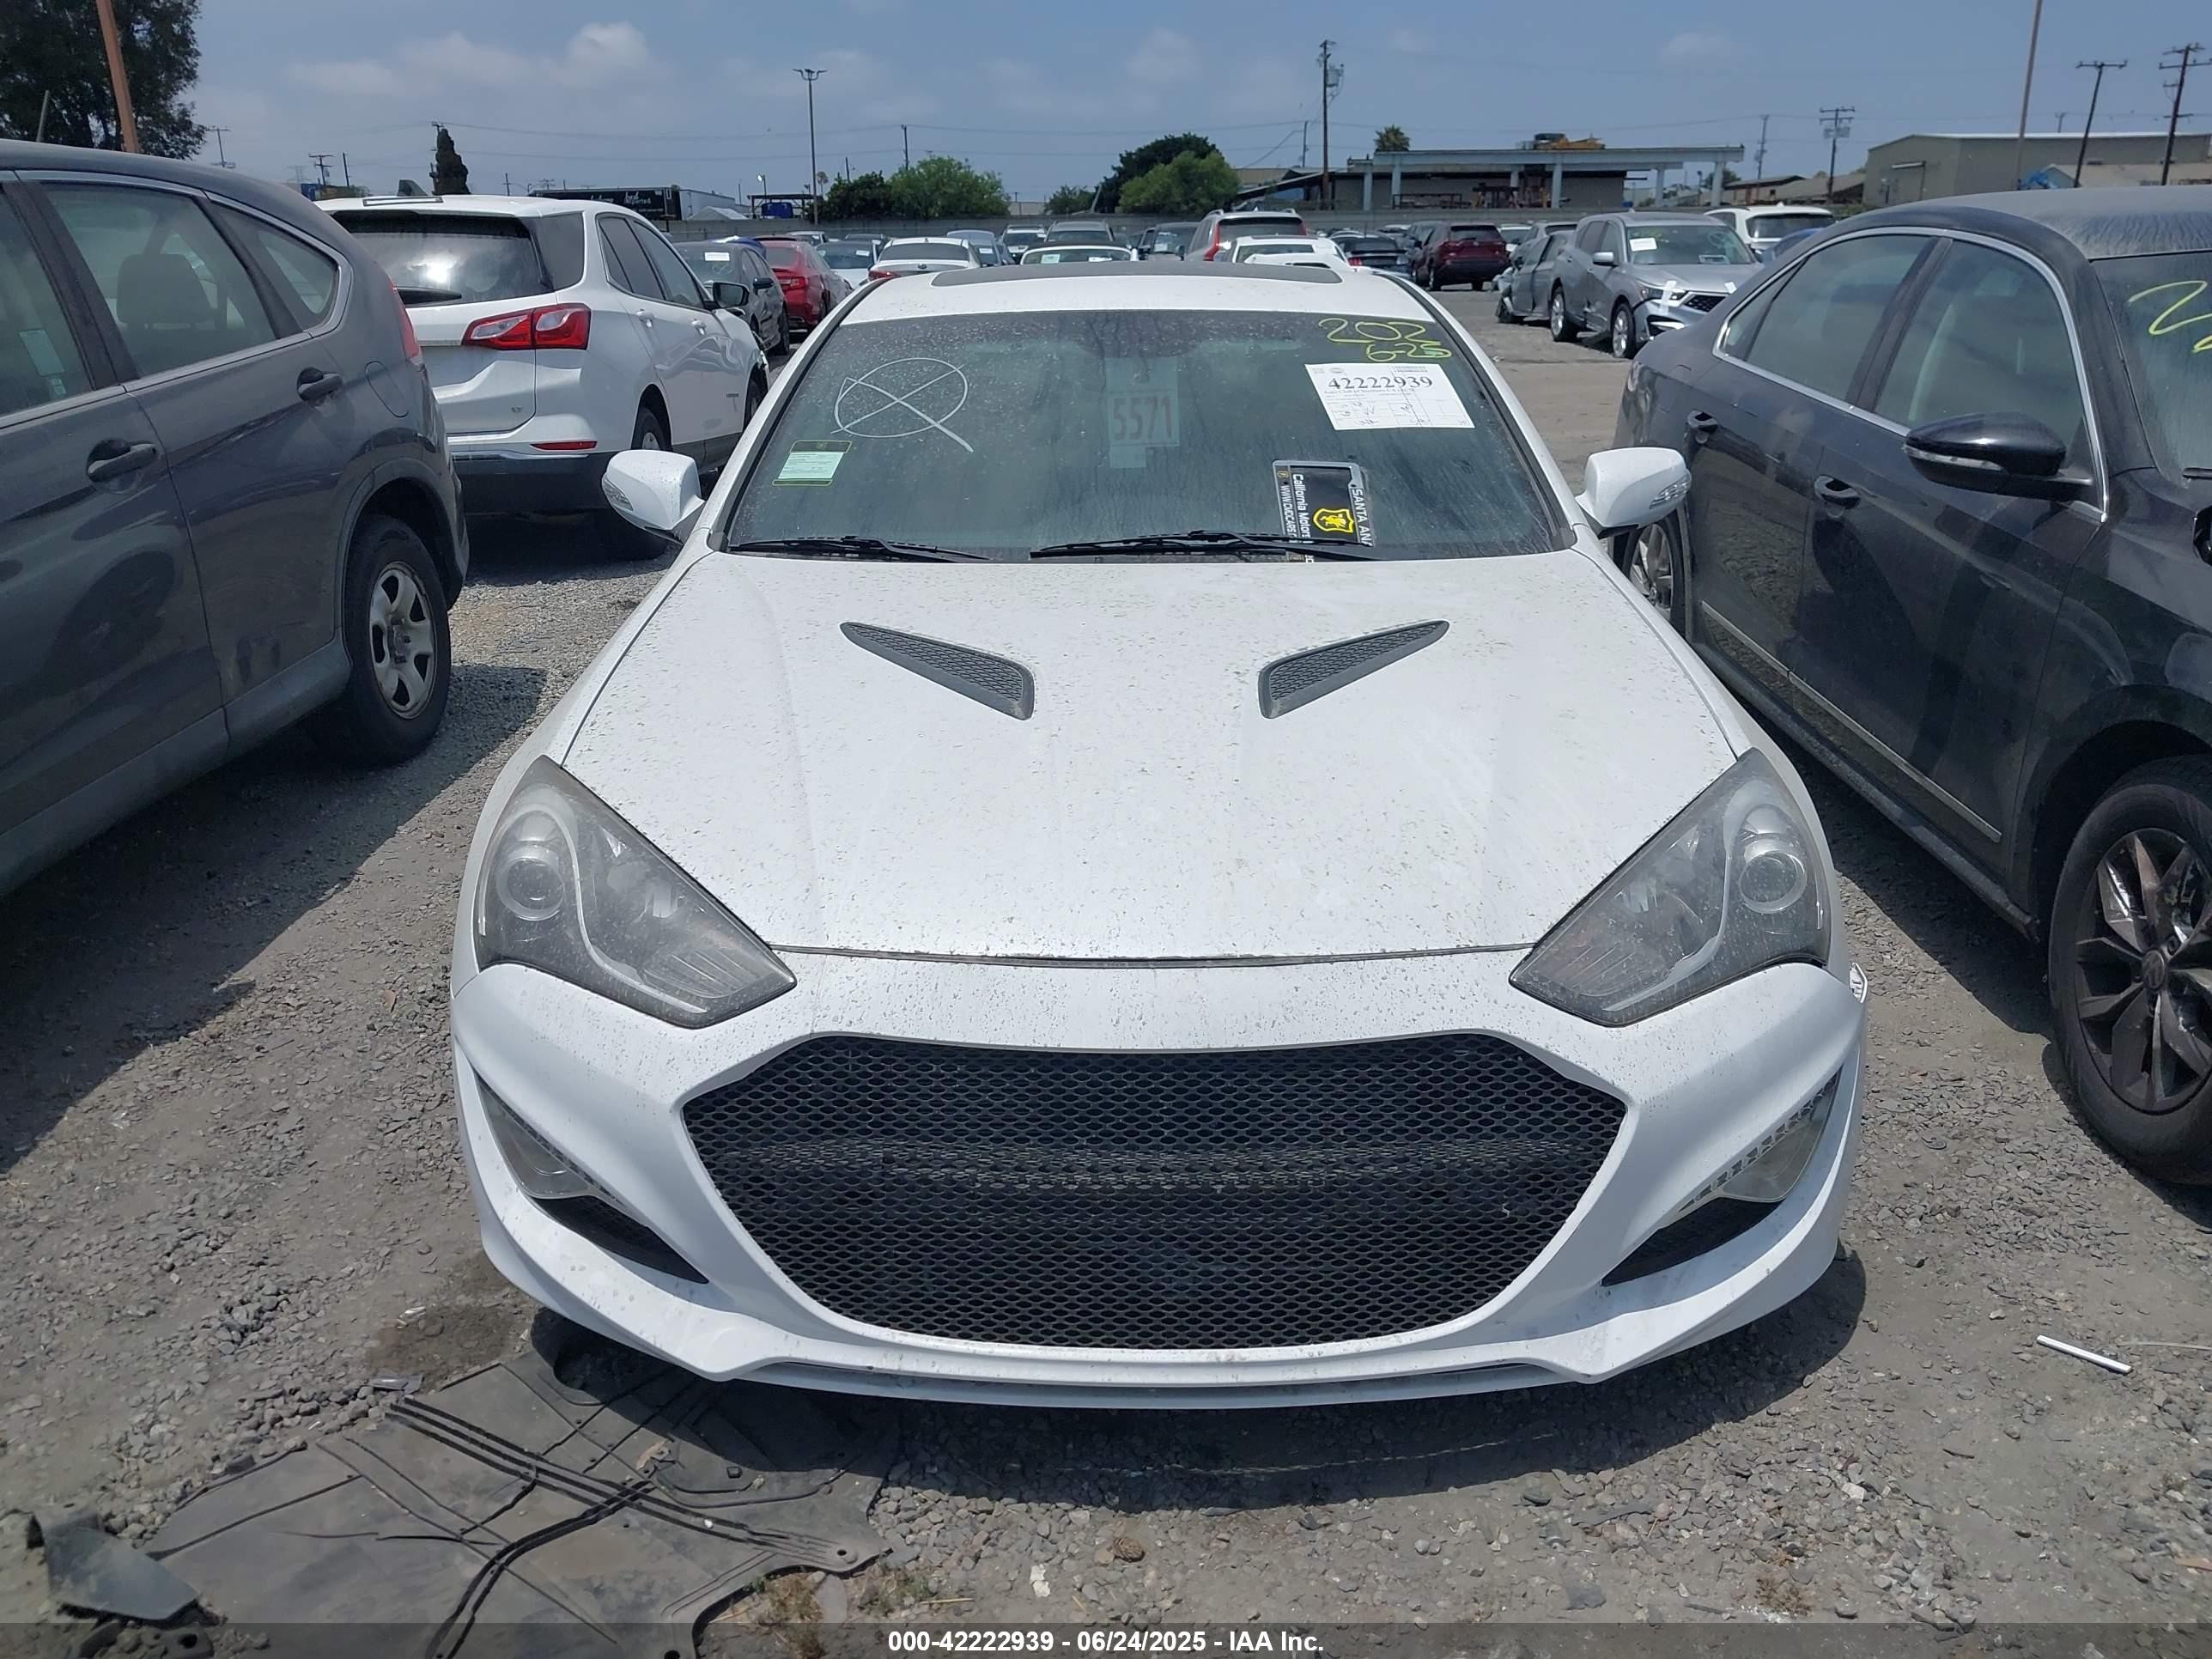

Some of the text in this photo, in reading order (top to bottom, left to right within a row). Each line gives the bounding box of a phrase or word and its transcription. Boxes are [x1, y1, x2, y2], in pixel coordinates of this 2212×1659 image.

[1328, 376, 1433, 390] 42222939
[1113, 396, 1173, 441] 5571
[1292, 473, 1307, 511] California
[1352, 488, 1368, 523] SANTA
